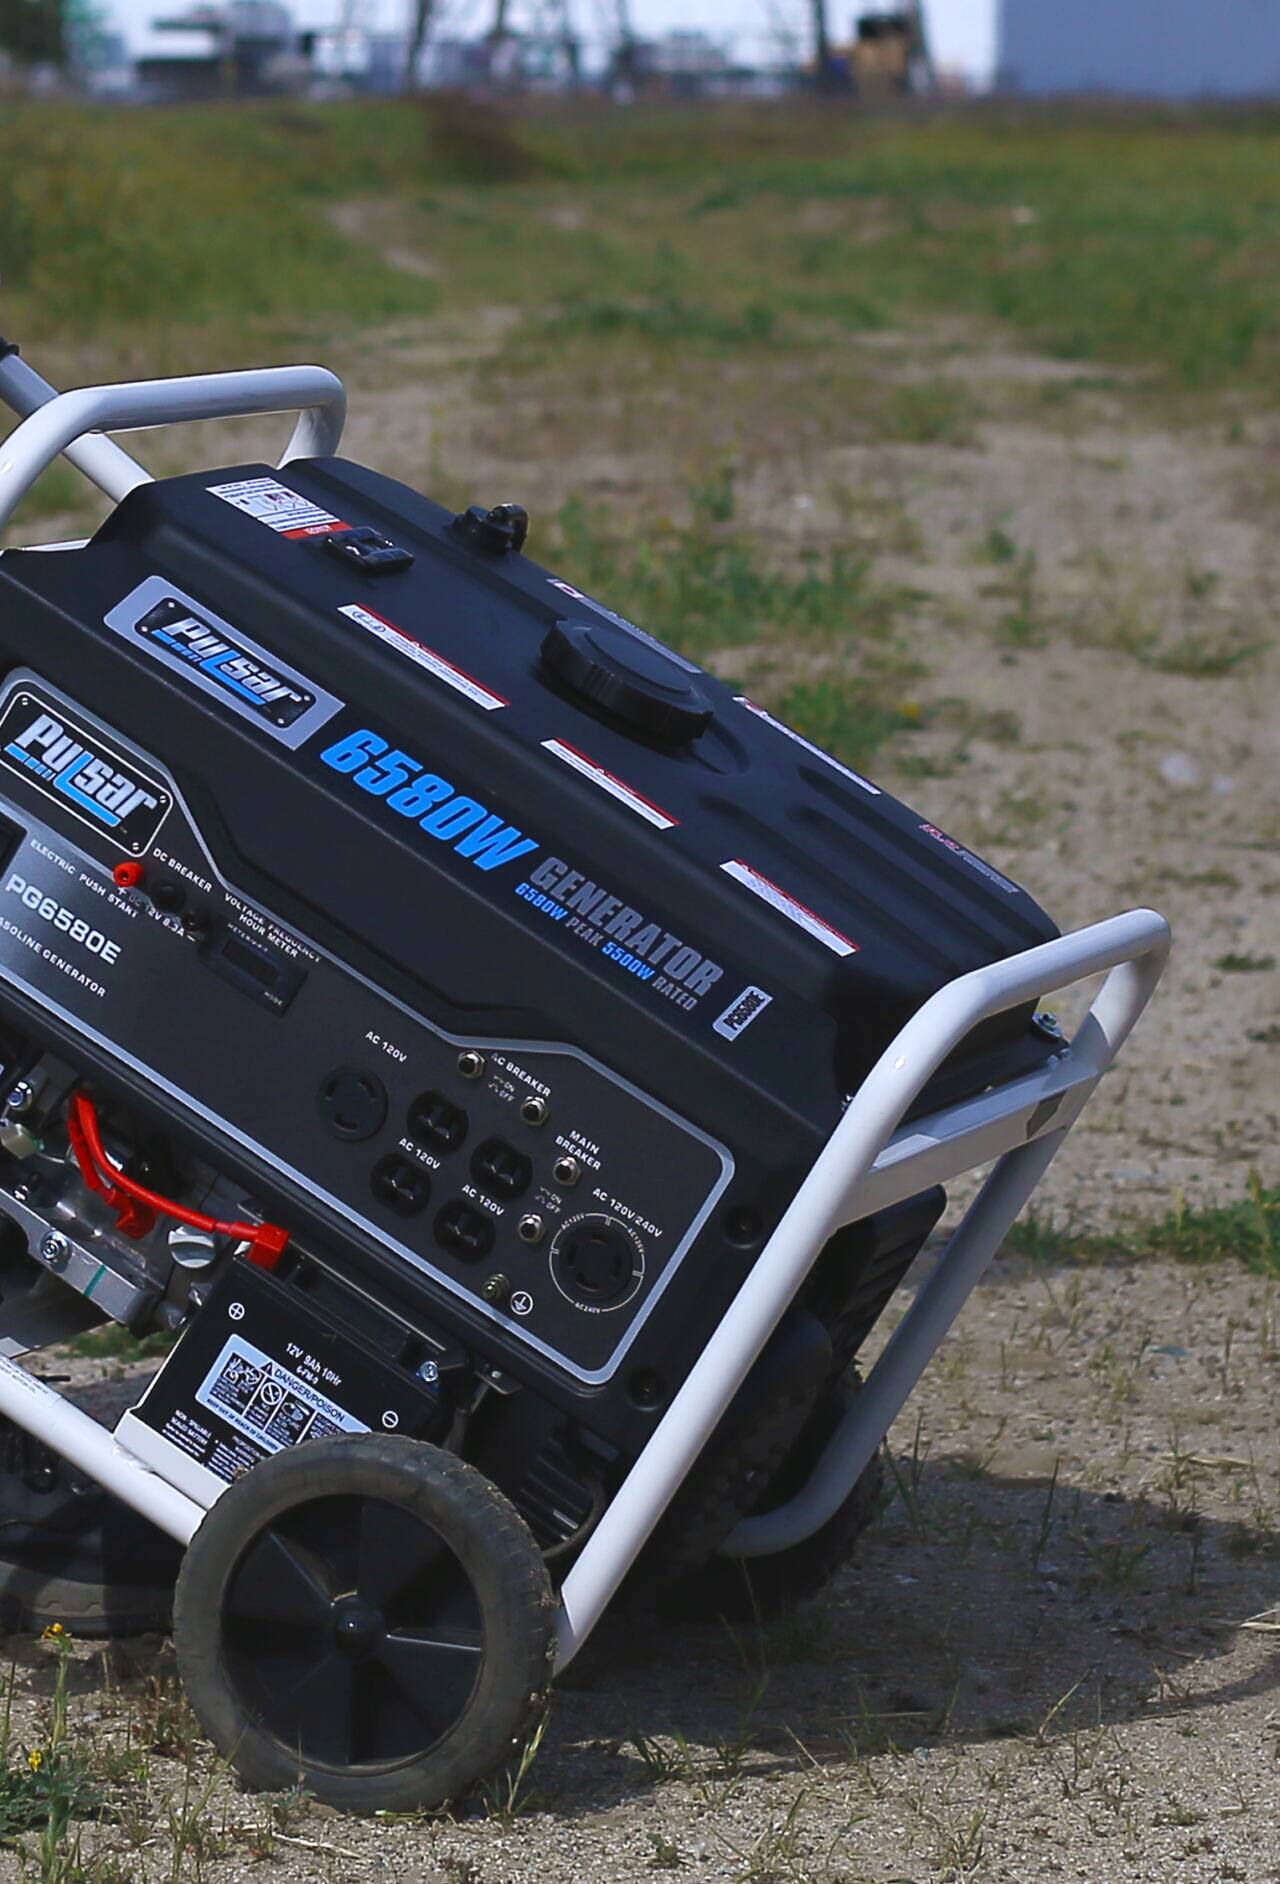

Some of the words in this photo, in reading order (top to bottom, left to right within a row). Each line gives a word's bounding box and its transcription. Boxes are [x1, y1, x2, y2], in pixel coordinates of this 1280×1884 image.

[320, 729, 540, 871] 6580W
[30, 839, 76, 875] ELECTRIC
[79, 873, 106, 896] PUSH
[108, 893, 138, 918] START
[153, 848, 168, 861] DC
[168, 859, 213, 893] BREAKER
[5, 874, 121, 965] PG6580E
[225, 893, 264, 924] VOLTAGE
[268, 924, 322, 963] FREQUENCY
[239, 913, 266, 937] HOUR
[267, 933, 299, 958] METER
[529, 857, 724, 997] GENERATOR
[515, 882, 569, 922] 6580W
[565, 916, 604, 947] PEAK
[602, 941, 655, 982] 5500W
[652, 975, 699, 1012] RATED
[43, 949, 106, 997] GENERATOR
[365, 1031, 381, 1046] AC
[382, 1040, 408, 1063] 120V
[491, 1052, 504, 1067] AC
[506, 1062, 552, 1097] BREAKER
[398, 1137, 414, 1152] AC
[415, 1148, 441, 1170] 120V
[555, 1136, 602, 1171] BREAKER
[569, 1130, 601, 1155] MAIN
[462, 1184, 477, 1199] AC
[478, 1195, 504, 1217] 120V
[592, 1187, 609, 1202] AC
[610, 1198, 663, 1239] 120V/240V
[286, 1342, 303, 1359] 12V
[322, 1367, 343, 1386] 10Hr
[273, 1369, 347, 1423] DANGER/POISON
